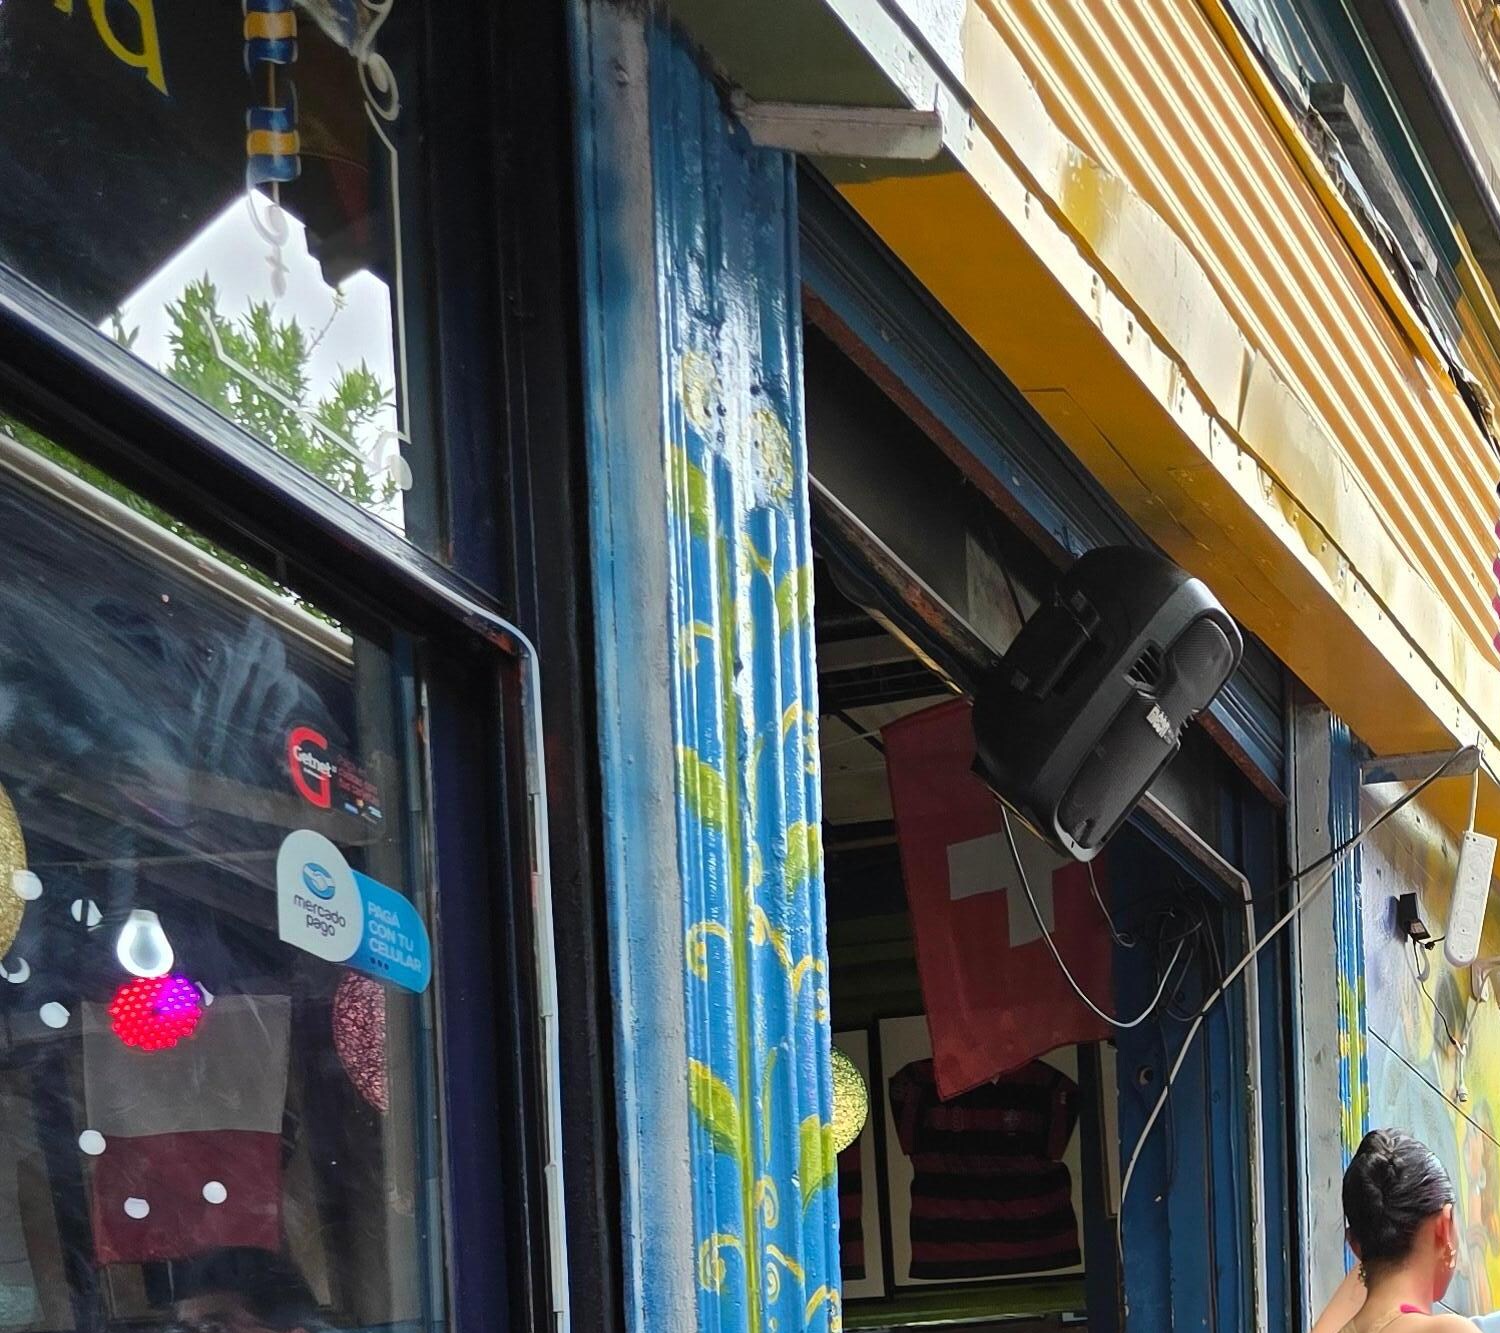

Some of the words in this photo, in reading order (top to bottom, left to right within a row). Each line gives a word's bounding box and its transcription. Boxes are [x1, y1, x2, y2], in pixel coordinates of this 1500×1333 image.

[293, 894, 346, 928] mercado
[306, 914, 336, 937] pago
[368, 920, 396, 944] CON
[397, 933, 414, 951] TU
[369, 937, 422, 973] CELULAR
